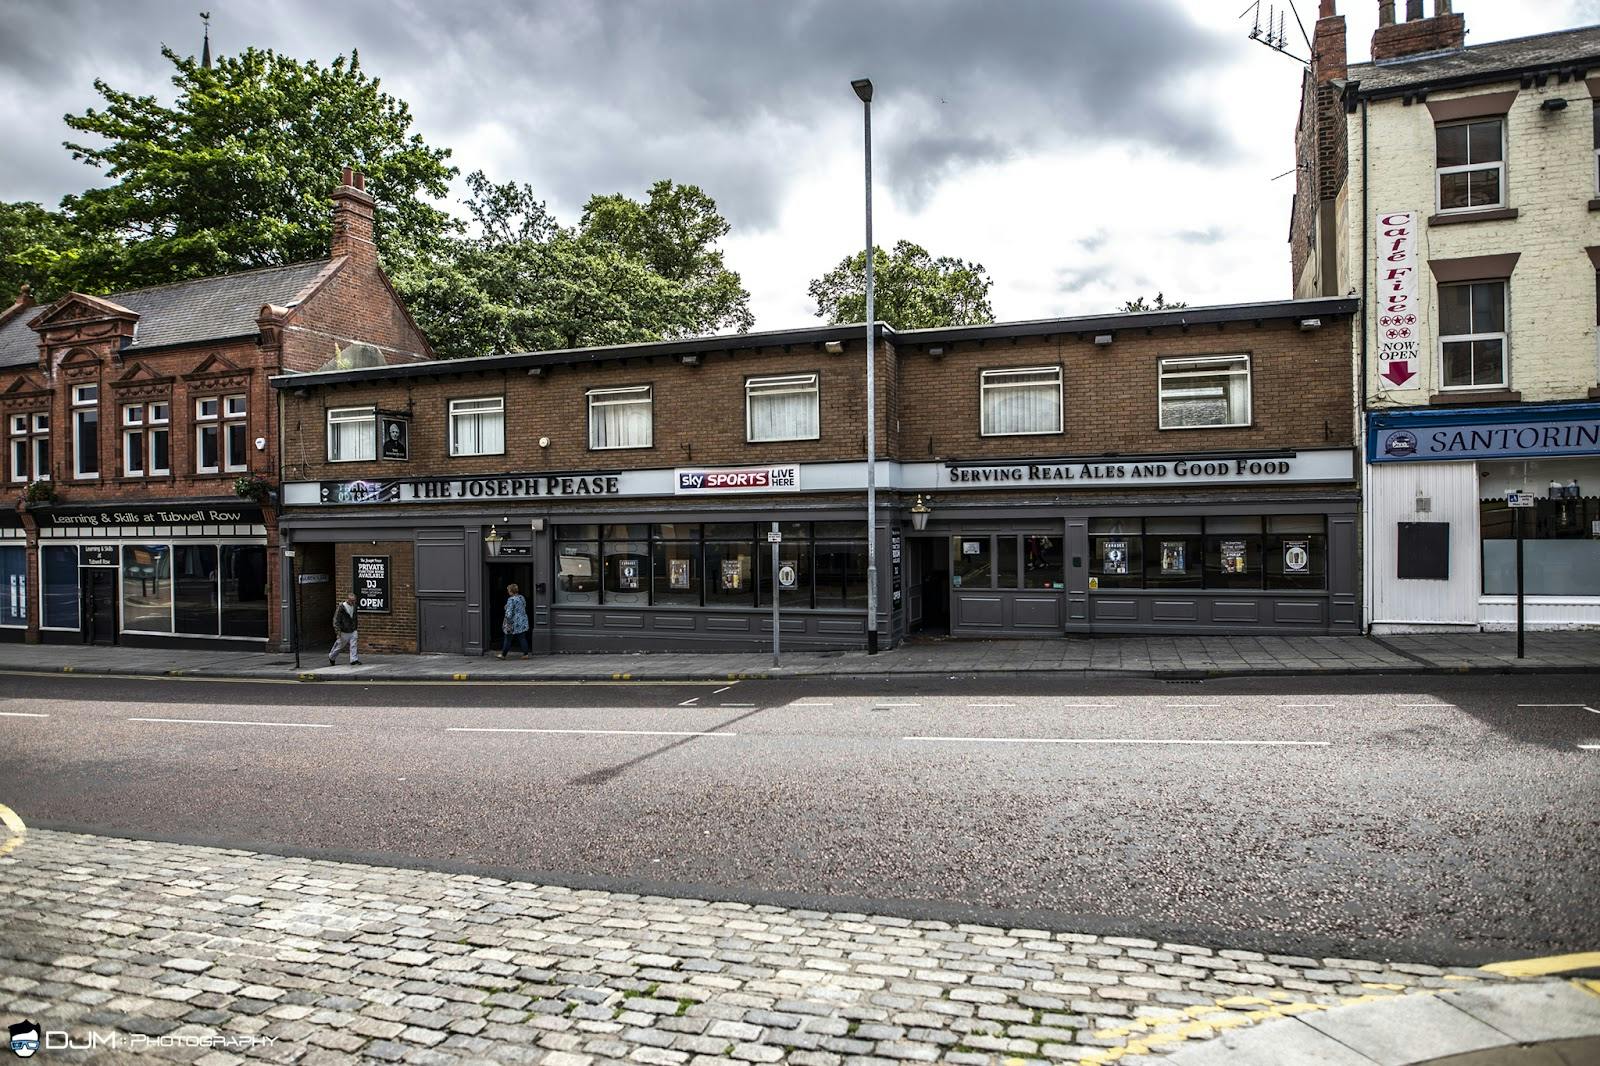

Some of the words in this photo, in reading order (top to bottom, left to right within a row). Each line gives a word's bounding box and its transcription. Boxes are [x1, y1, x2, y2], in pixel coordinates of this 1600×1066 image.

[1383, 267, 1412, 313] Five
[1383, 341, 1416, 351] NOW
[1379, 350, 1418, 361] OPEN
[1429, 425, 1600, 452] SANTORIN
[771, 469, 794, 478] LIVE
[950, 466, 1023, 482] SERVING
[1029, 464, 1075, 480] REAL
[1080, 463, 1126, 479] ALES
[1174, 460, 1229, 476] GOOD
[1235, 459, 1290, 475] FOOD
[682, 474, 704, 488] sky
[707, 472, 767, 486] SPORTS
[772, 478, 794, 487] HERE
[409, 480, 451, 498] THE
[458, 478, 540, 497] JOSEPH
[546, 476, 619, 495] PEASE
[52, 513, 99, 526] Learning
[101, 513, 111, 523] &
[113, 512, 139, 523] Skills
[143, 513, 155, 522] at
[157, 511, 205, 522] Tubwell
[210, 510, 241, 521] Row
[358, 563, 385, 571] PRIVATE
[366, 580, 377, 588] DJ
[360, 598, 384, 608] OPEN
